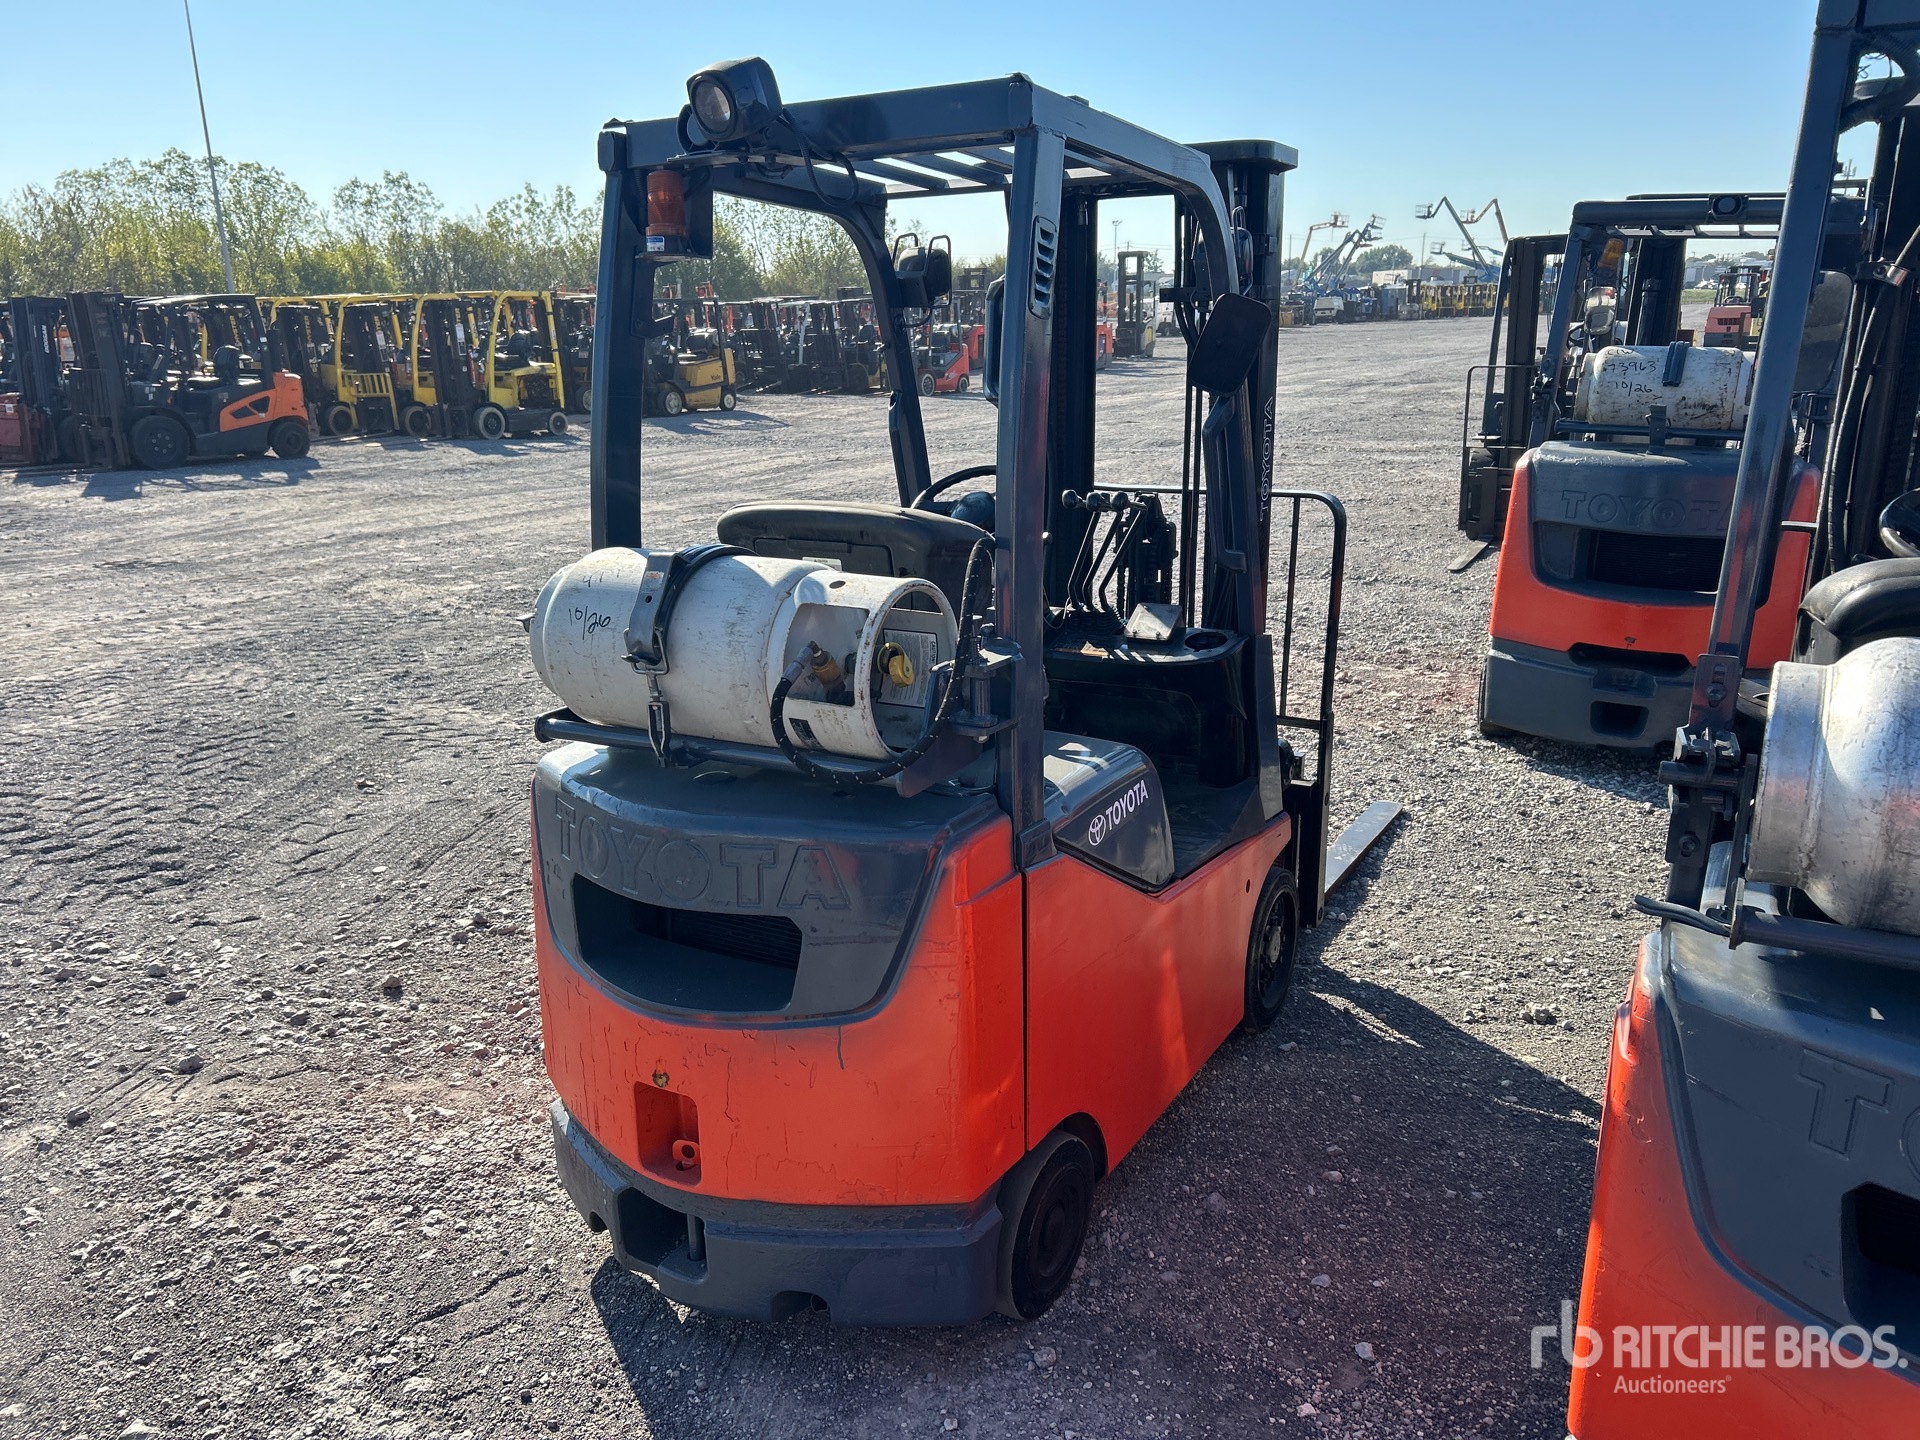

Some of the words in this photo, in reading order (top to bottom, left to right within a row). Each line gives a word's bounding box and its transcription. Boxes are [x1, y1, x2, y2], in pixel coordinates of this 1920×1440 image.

[41, 324, 50, 354] DOOSAN
[1260, 396, 1273, 521] TOYOTA
[568, 606, 611, 640] 10/26
[1105, 779, 1149, 830] TOYOTA
[556, 794, 850, 910] TOYOTA
